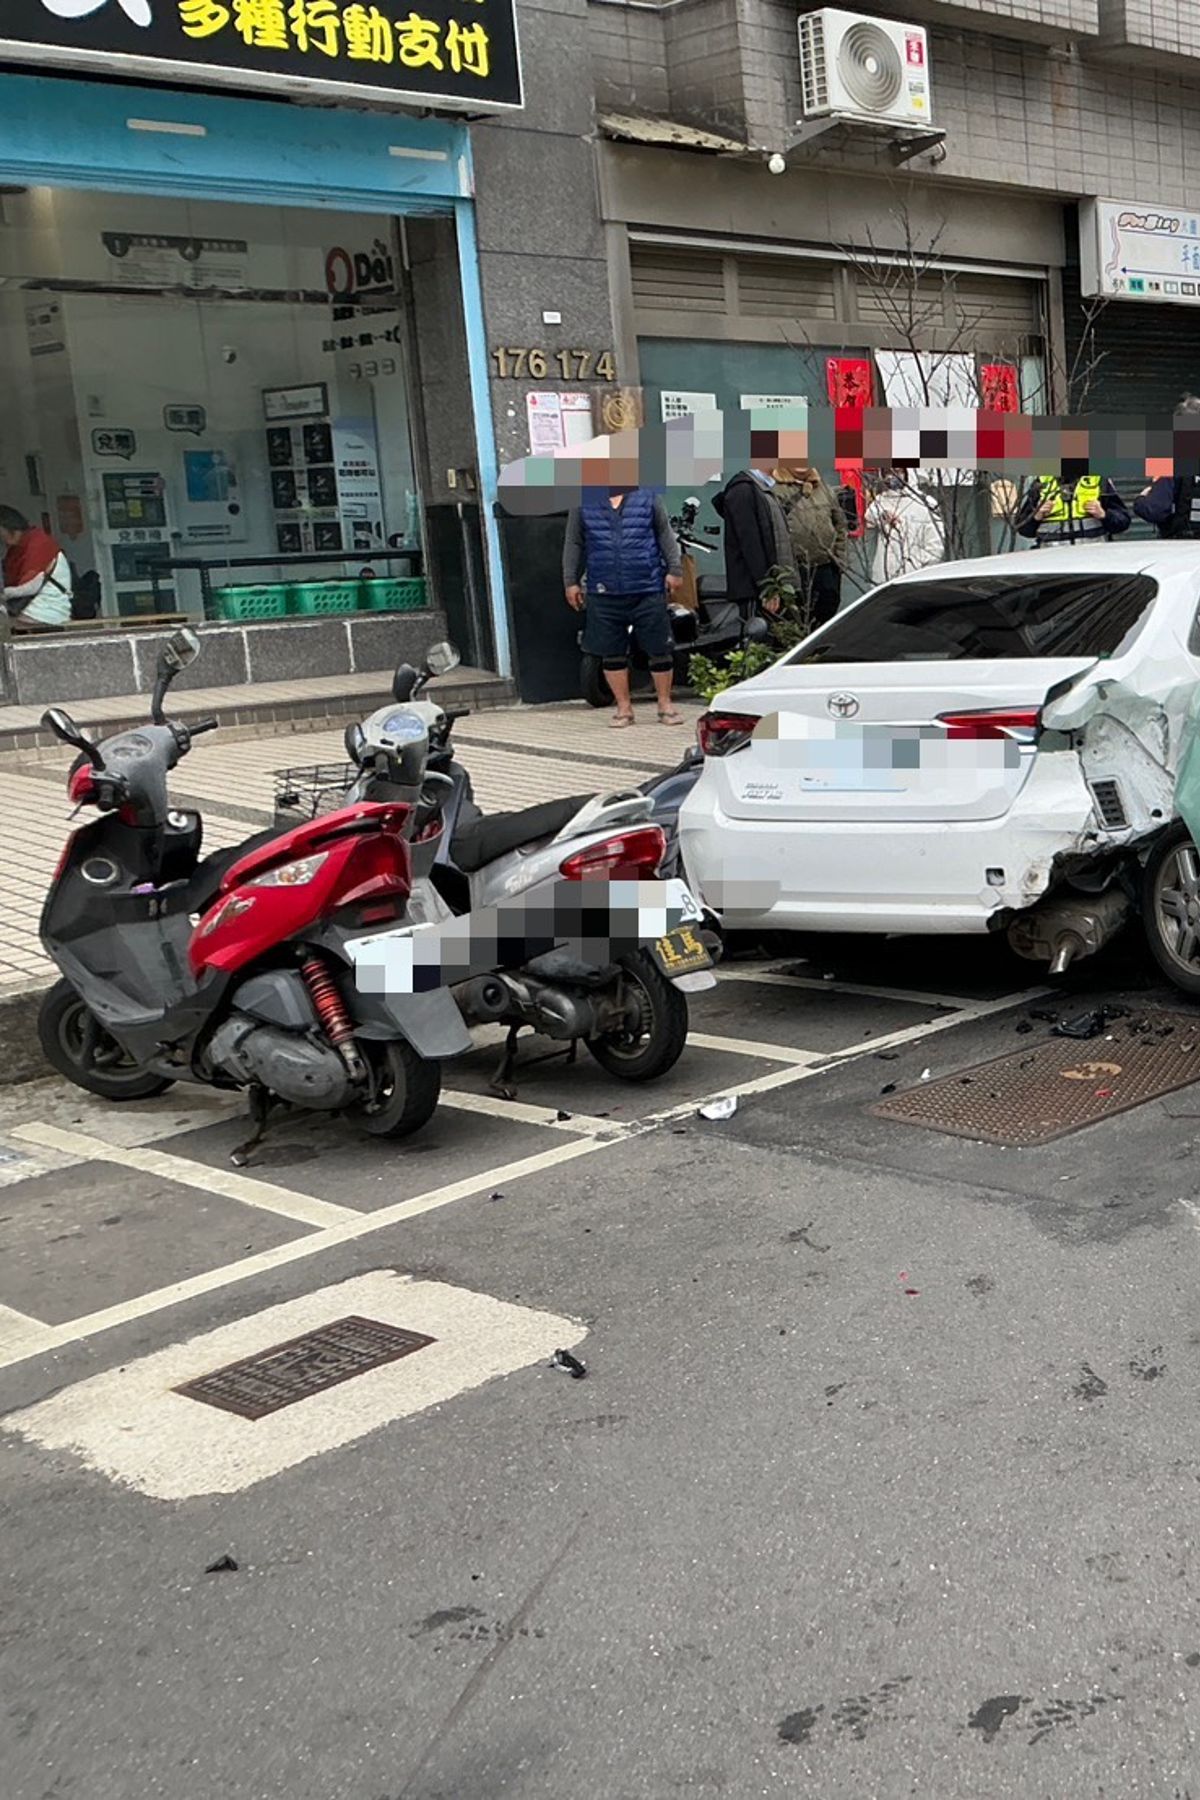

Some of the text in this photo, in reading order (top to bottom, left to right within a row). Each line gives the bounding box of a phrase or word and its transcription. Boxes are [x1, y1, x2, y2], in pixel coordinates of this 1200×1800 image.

[178, 0, 491, 78] 多種行動支付
[493, 347, 548, 378] 176
[556, 350, 616, 381] 174
